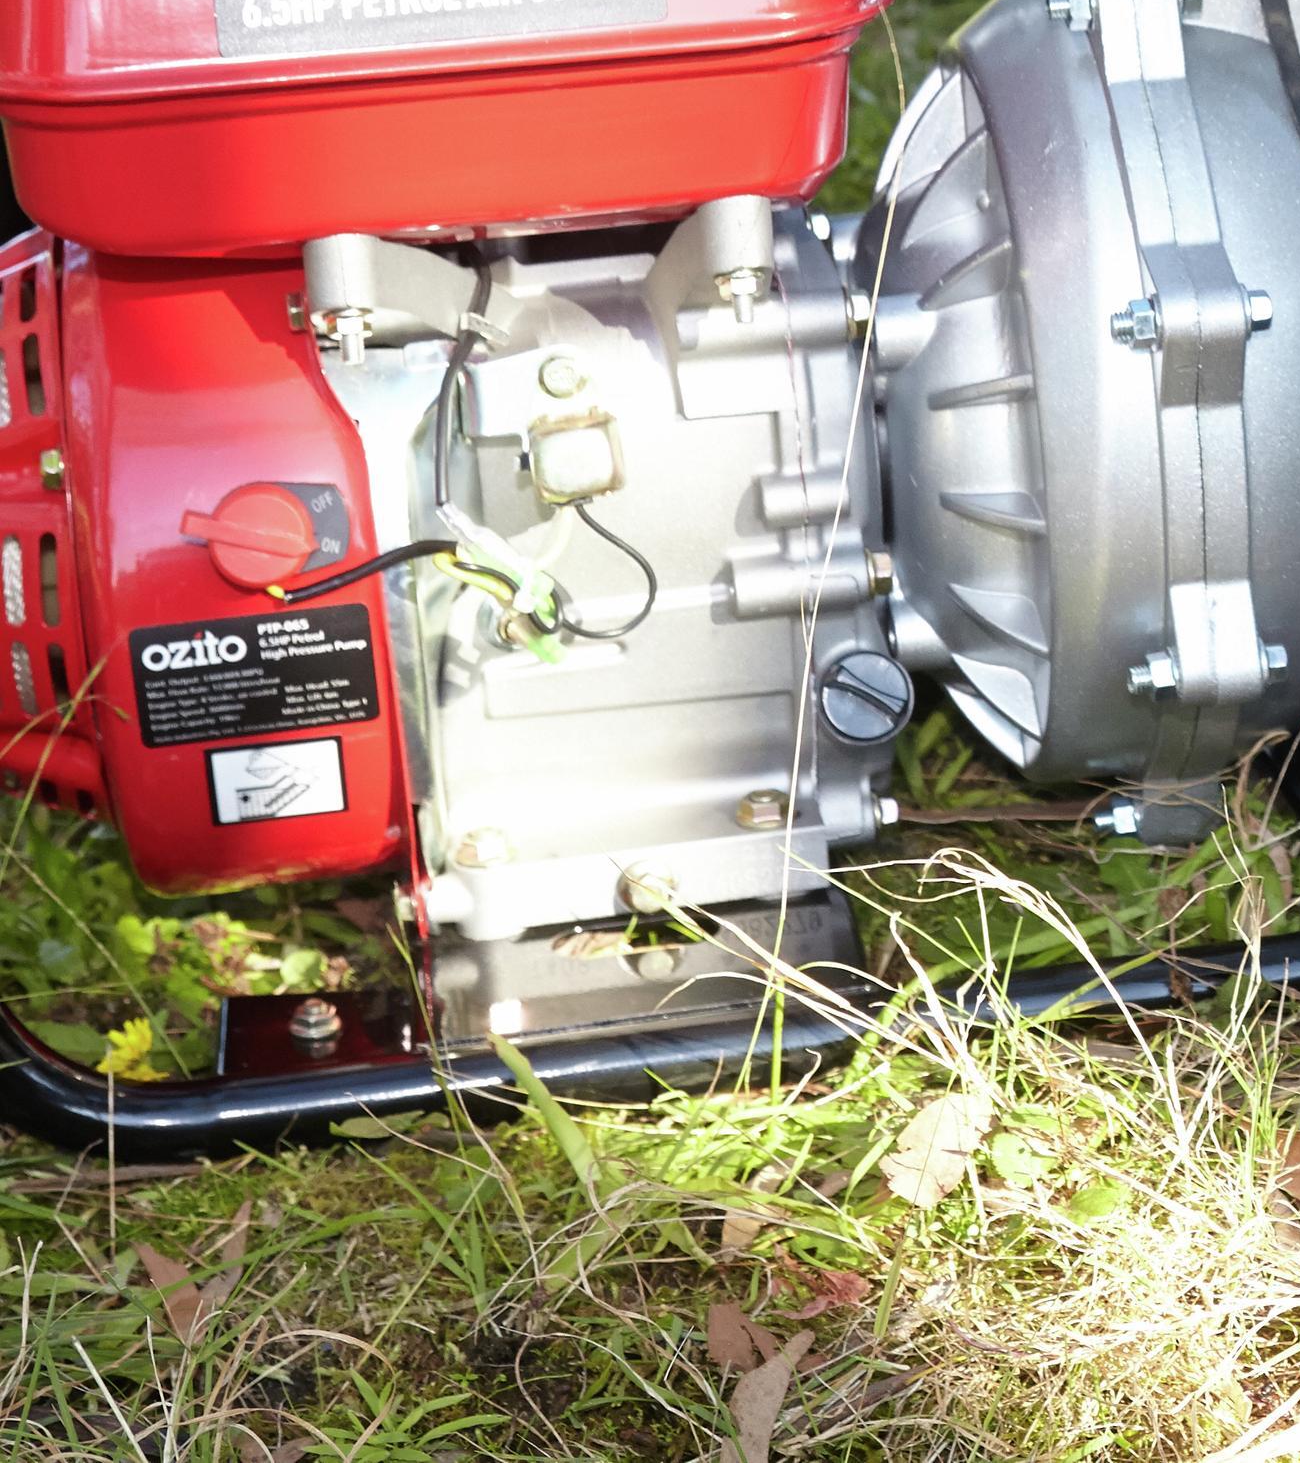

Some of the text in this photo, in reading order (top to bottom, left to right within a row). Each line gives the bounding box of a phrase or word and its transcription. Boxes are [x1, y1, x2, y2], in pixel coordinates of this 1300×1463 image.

[311, 491, 334, 513] OFF
[321, 537, 341, 554] ON
[292, 630, 325, 645] Petrol
[141, 630, 247, 672] ozito
[261, 638, 367, 661] High Pressure Pump
